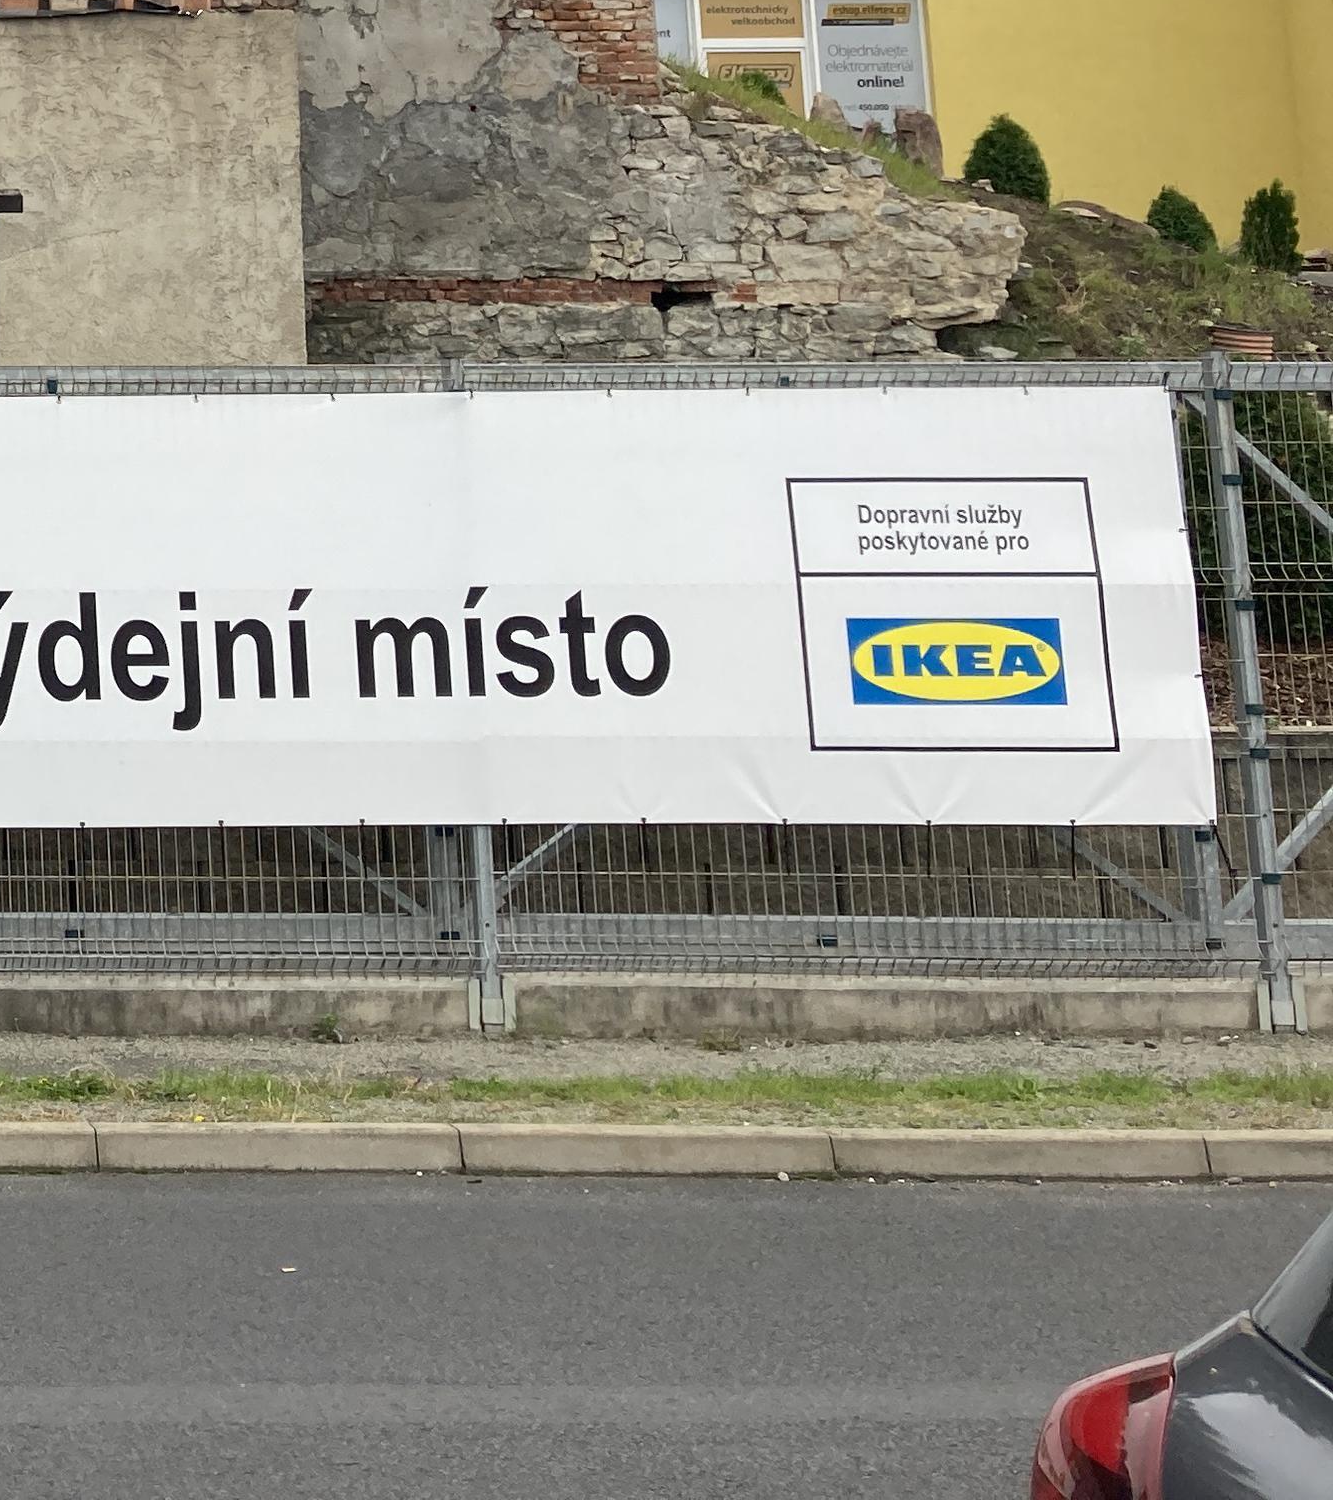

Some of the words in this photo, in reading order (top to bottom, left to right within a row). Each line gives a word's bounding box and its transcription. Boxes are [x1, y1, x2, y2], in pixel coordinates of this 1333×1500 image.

[856, 75, 905, 88] online!
[857, 503, 950, 529] Dopravní
[956, 503, 1022, 529] služby
[858, 530, 989, 556] poskytované
[995, 535, 1030, 556] pro
[354, 586, 671, 698] místo
[871, 644, 1047, 677] IKEA
